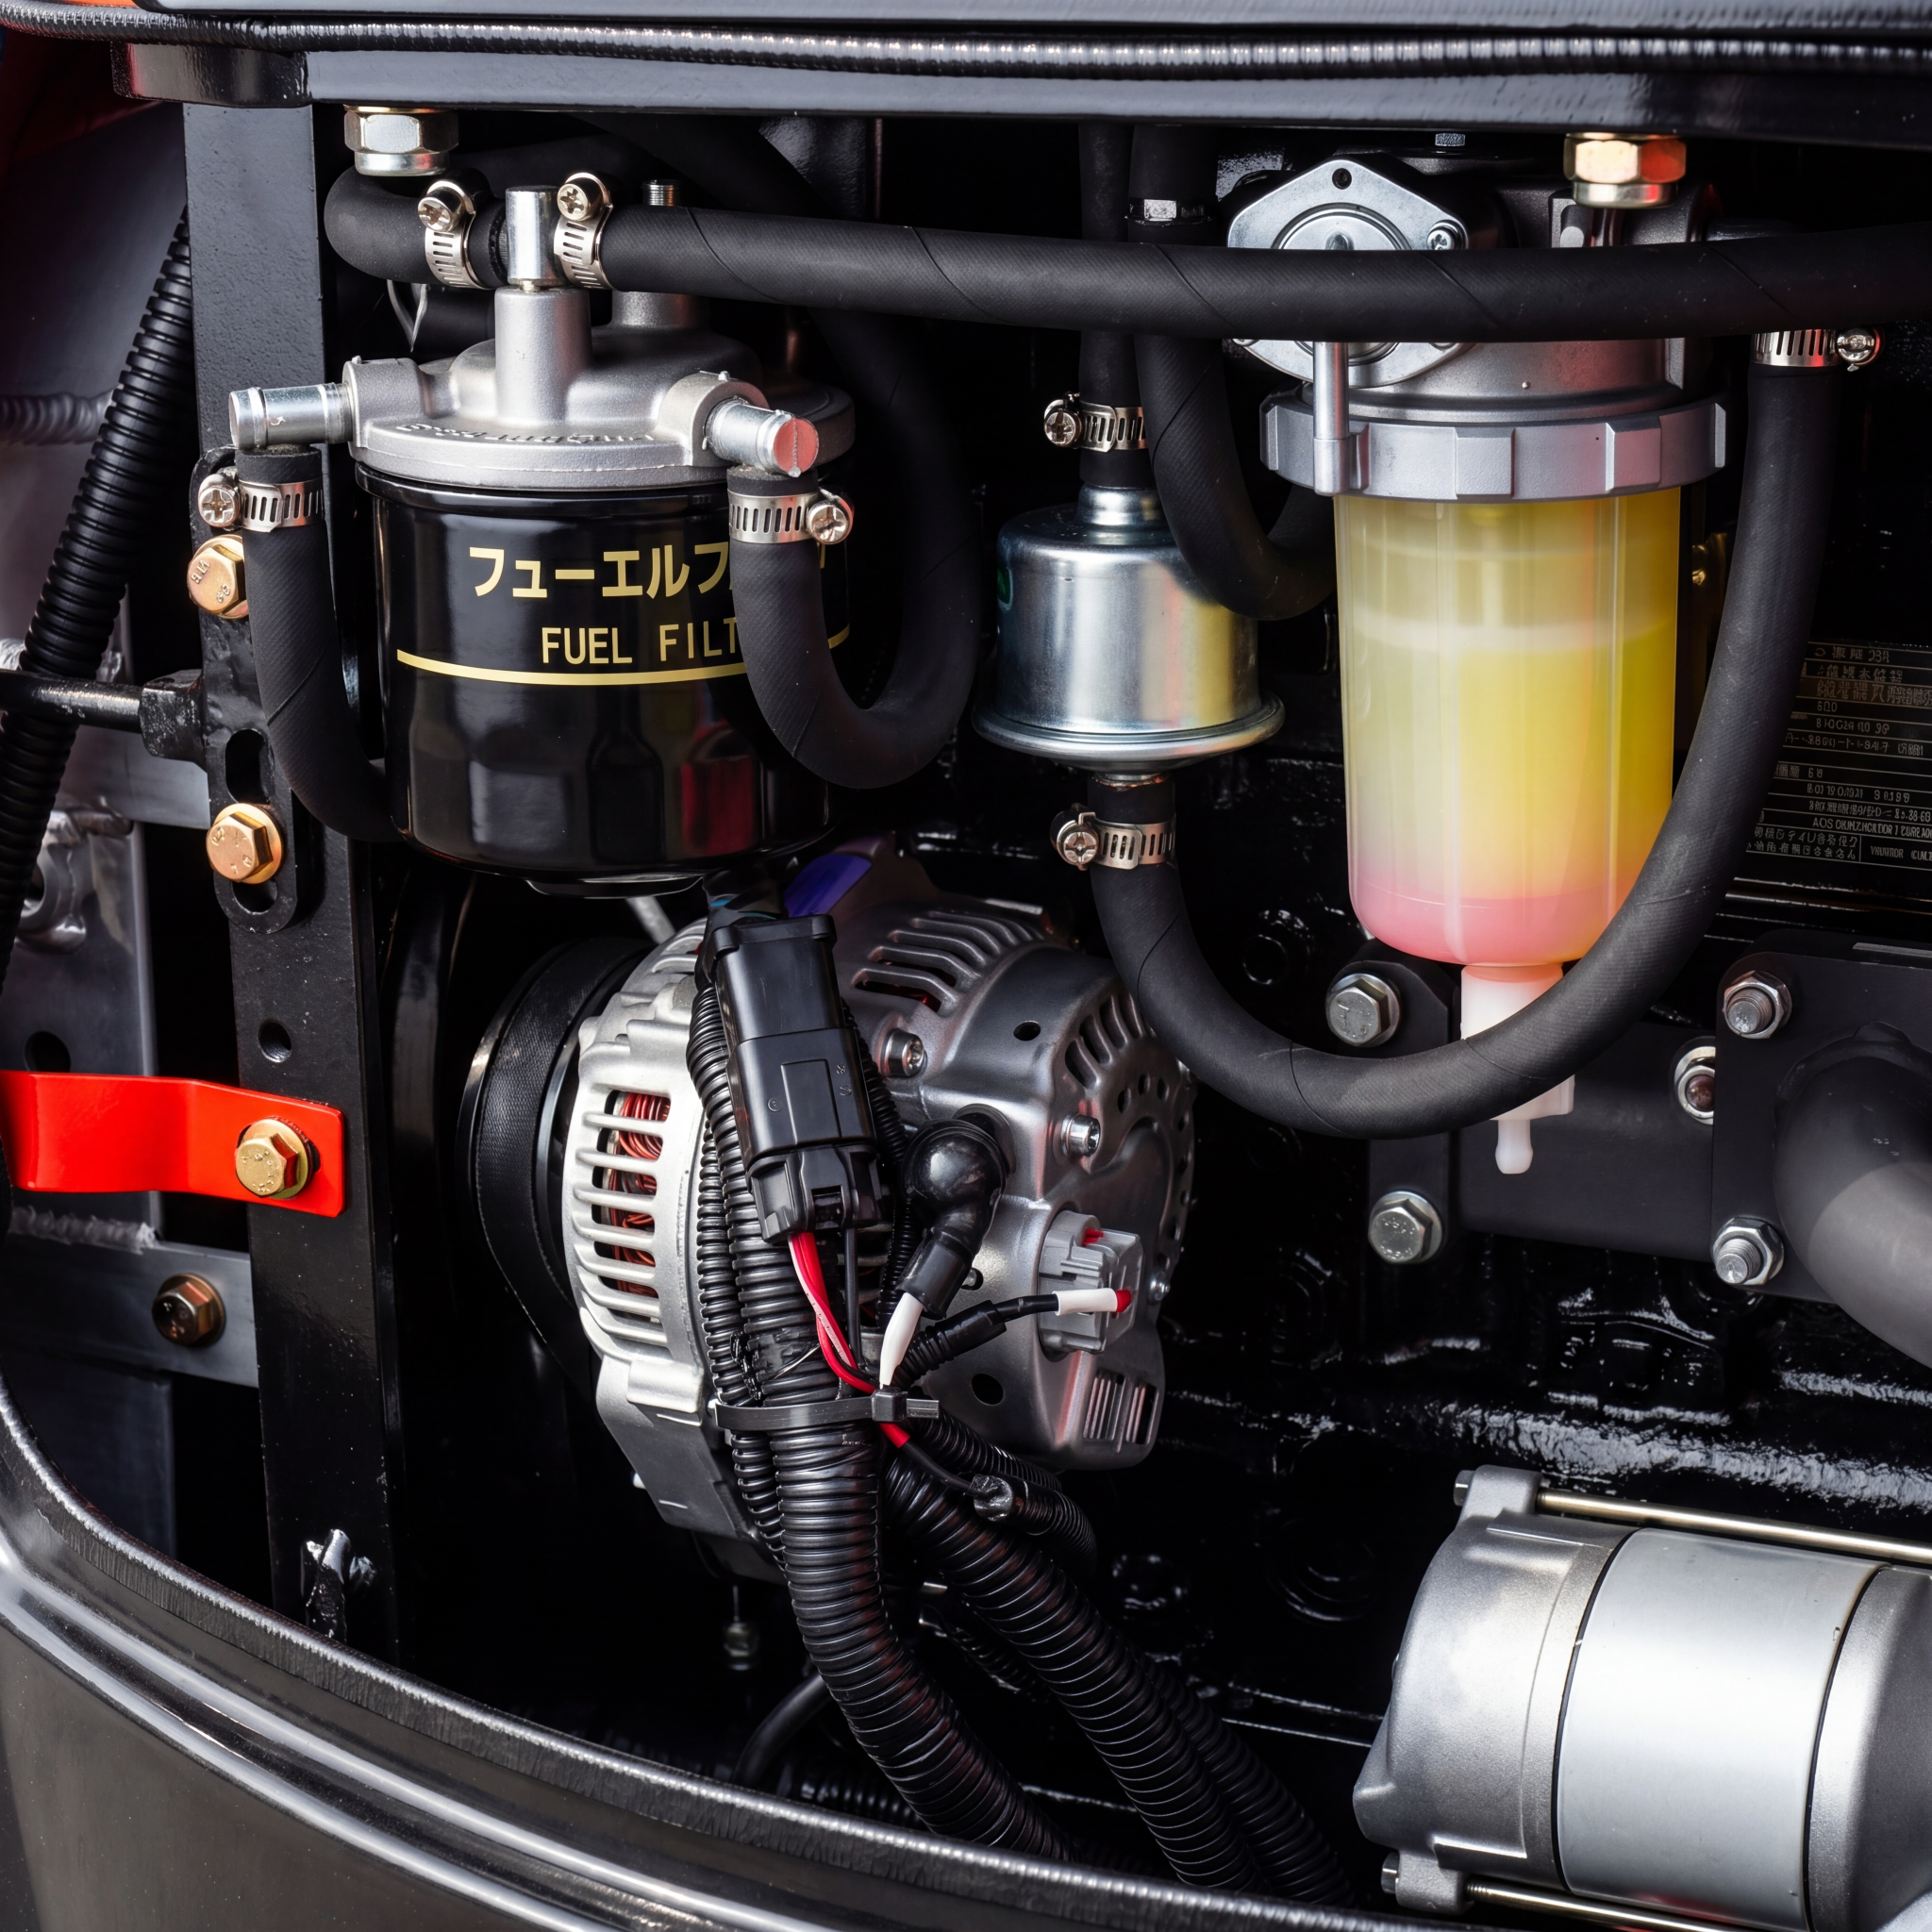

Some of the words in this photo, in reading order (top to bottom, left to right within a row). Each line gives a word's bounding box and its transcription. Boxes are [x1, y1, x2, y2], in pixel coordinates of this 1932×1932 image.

[470, 541, 732, 599] フューエルフ
[542, 626, 633, 665] FUEL
